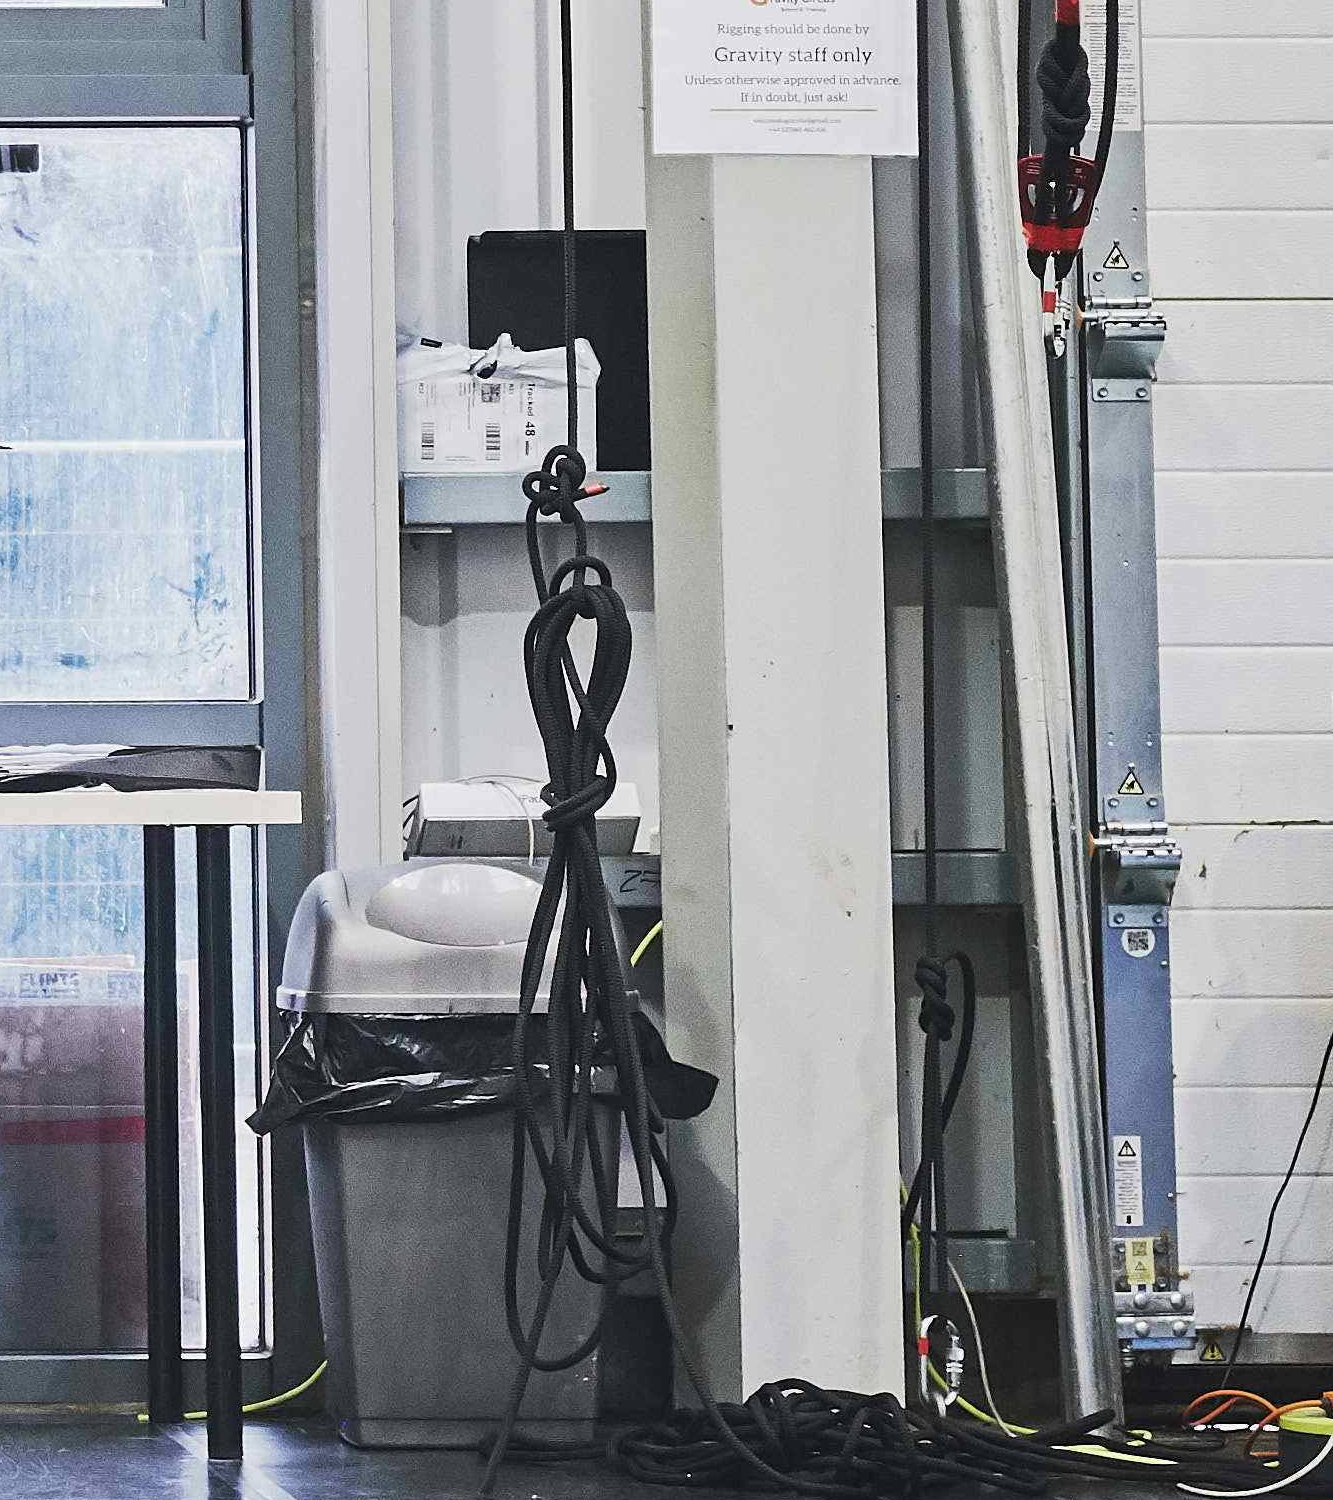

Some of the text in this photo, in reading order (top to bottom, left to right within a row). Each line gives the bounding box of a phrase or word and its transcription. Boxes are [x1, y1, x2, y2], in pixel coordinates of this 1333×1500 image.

[717, 23, 870, 36] Rigging should be done by
[714, 46, 872, 65] Gravity staff only
[685, 76, 723, 85] Unless
[725, 75, 780, 85] otherwise
[784, 76, 836, 88] approved
[839, 76, 850, 85] in
[740, 92, 750, 102] If
[752, 93, 763, 102] in
[804, 93, 824, 104] just
[827, 92, 848, 102] ask!
[526, 382, 536, 417] Tracked
[524, 421, 536, 437] 48
